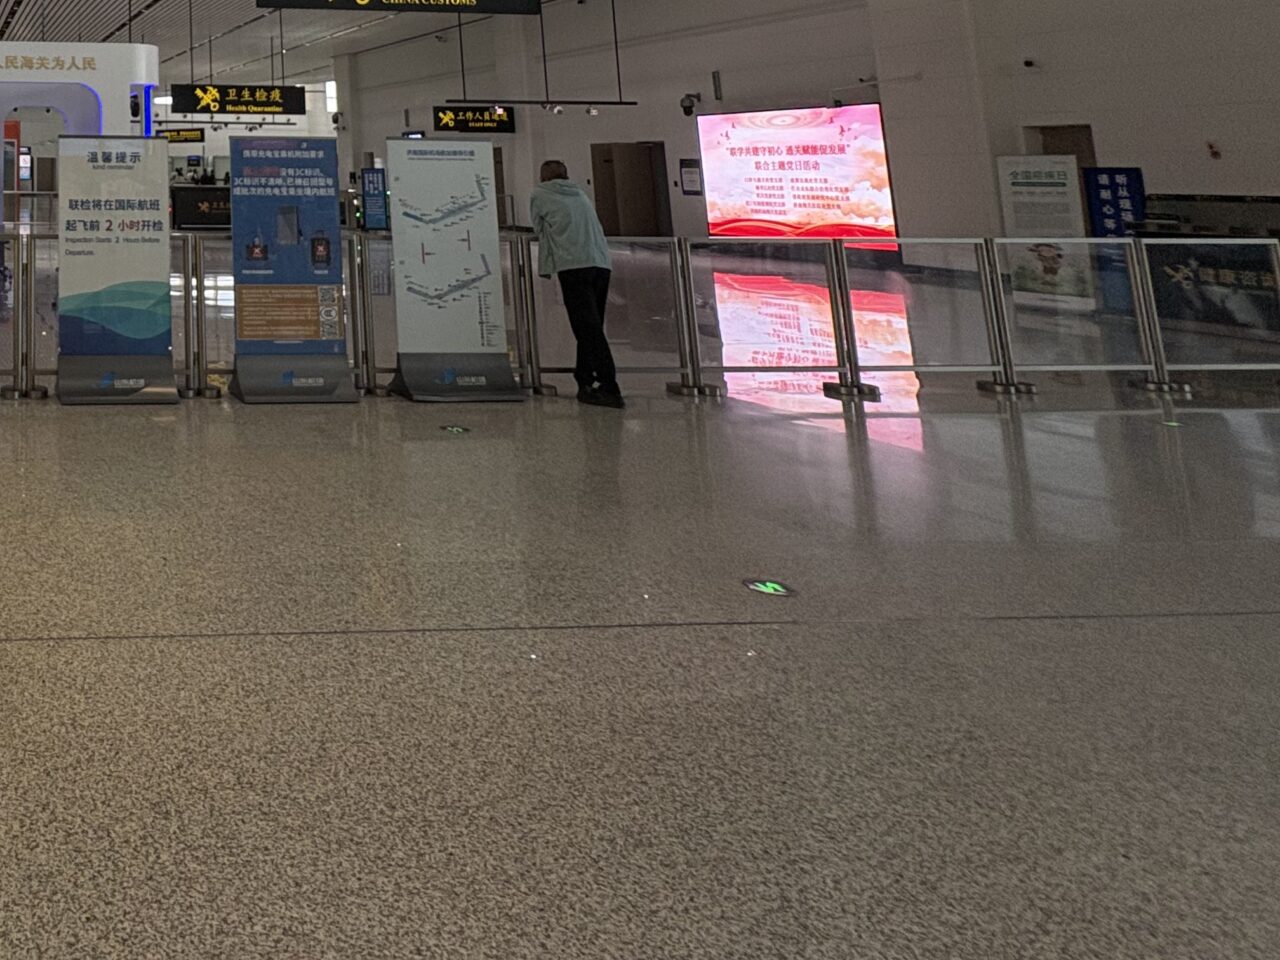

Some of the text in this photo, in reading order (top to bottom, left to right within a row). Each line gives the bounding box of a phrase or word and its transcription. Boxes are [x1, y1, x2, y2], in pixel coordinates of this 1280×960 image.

[225, 88, 284, 103] 卫生检疫
[226, 104, 284, 113] Health Quarantine
[87, 151, 141, 163] 温馨提示
[68, 198, 161, 211] 联检将在国际航班
[1097, 174, 1118, 238] 请耐心等
[1115, 174, 1136, 237] 听从现场
[65, 219, 164, 232] 起飞前 2 小时开检
